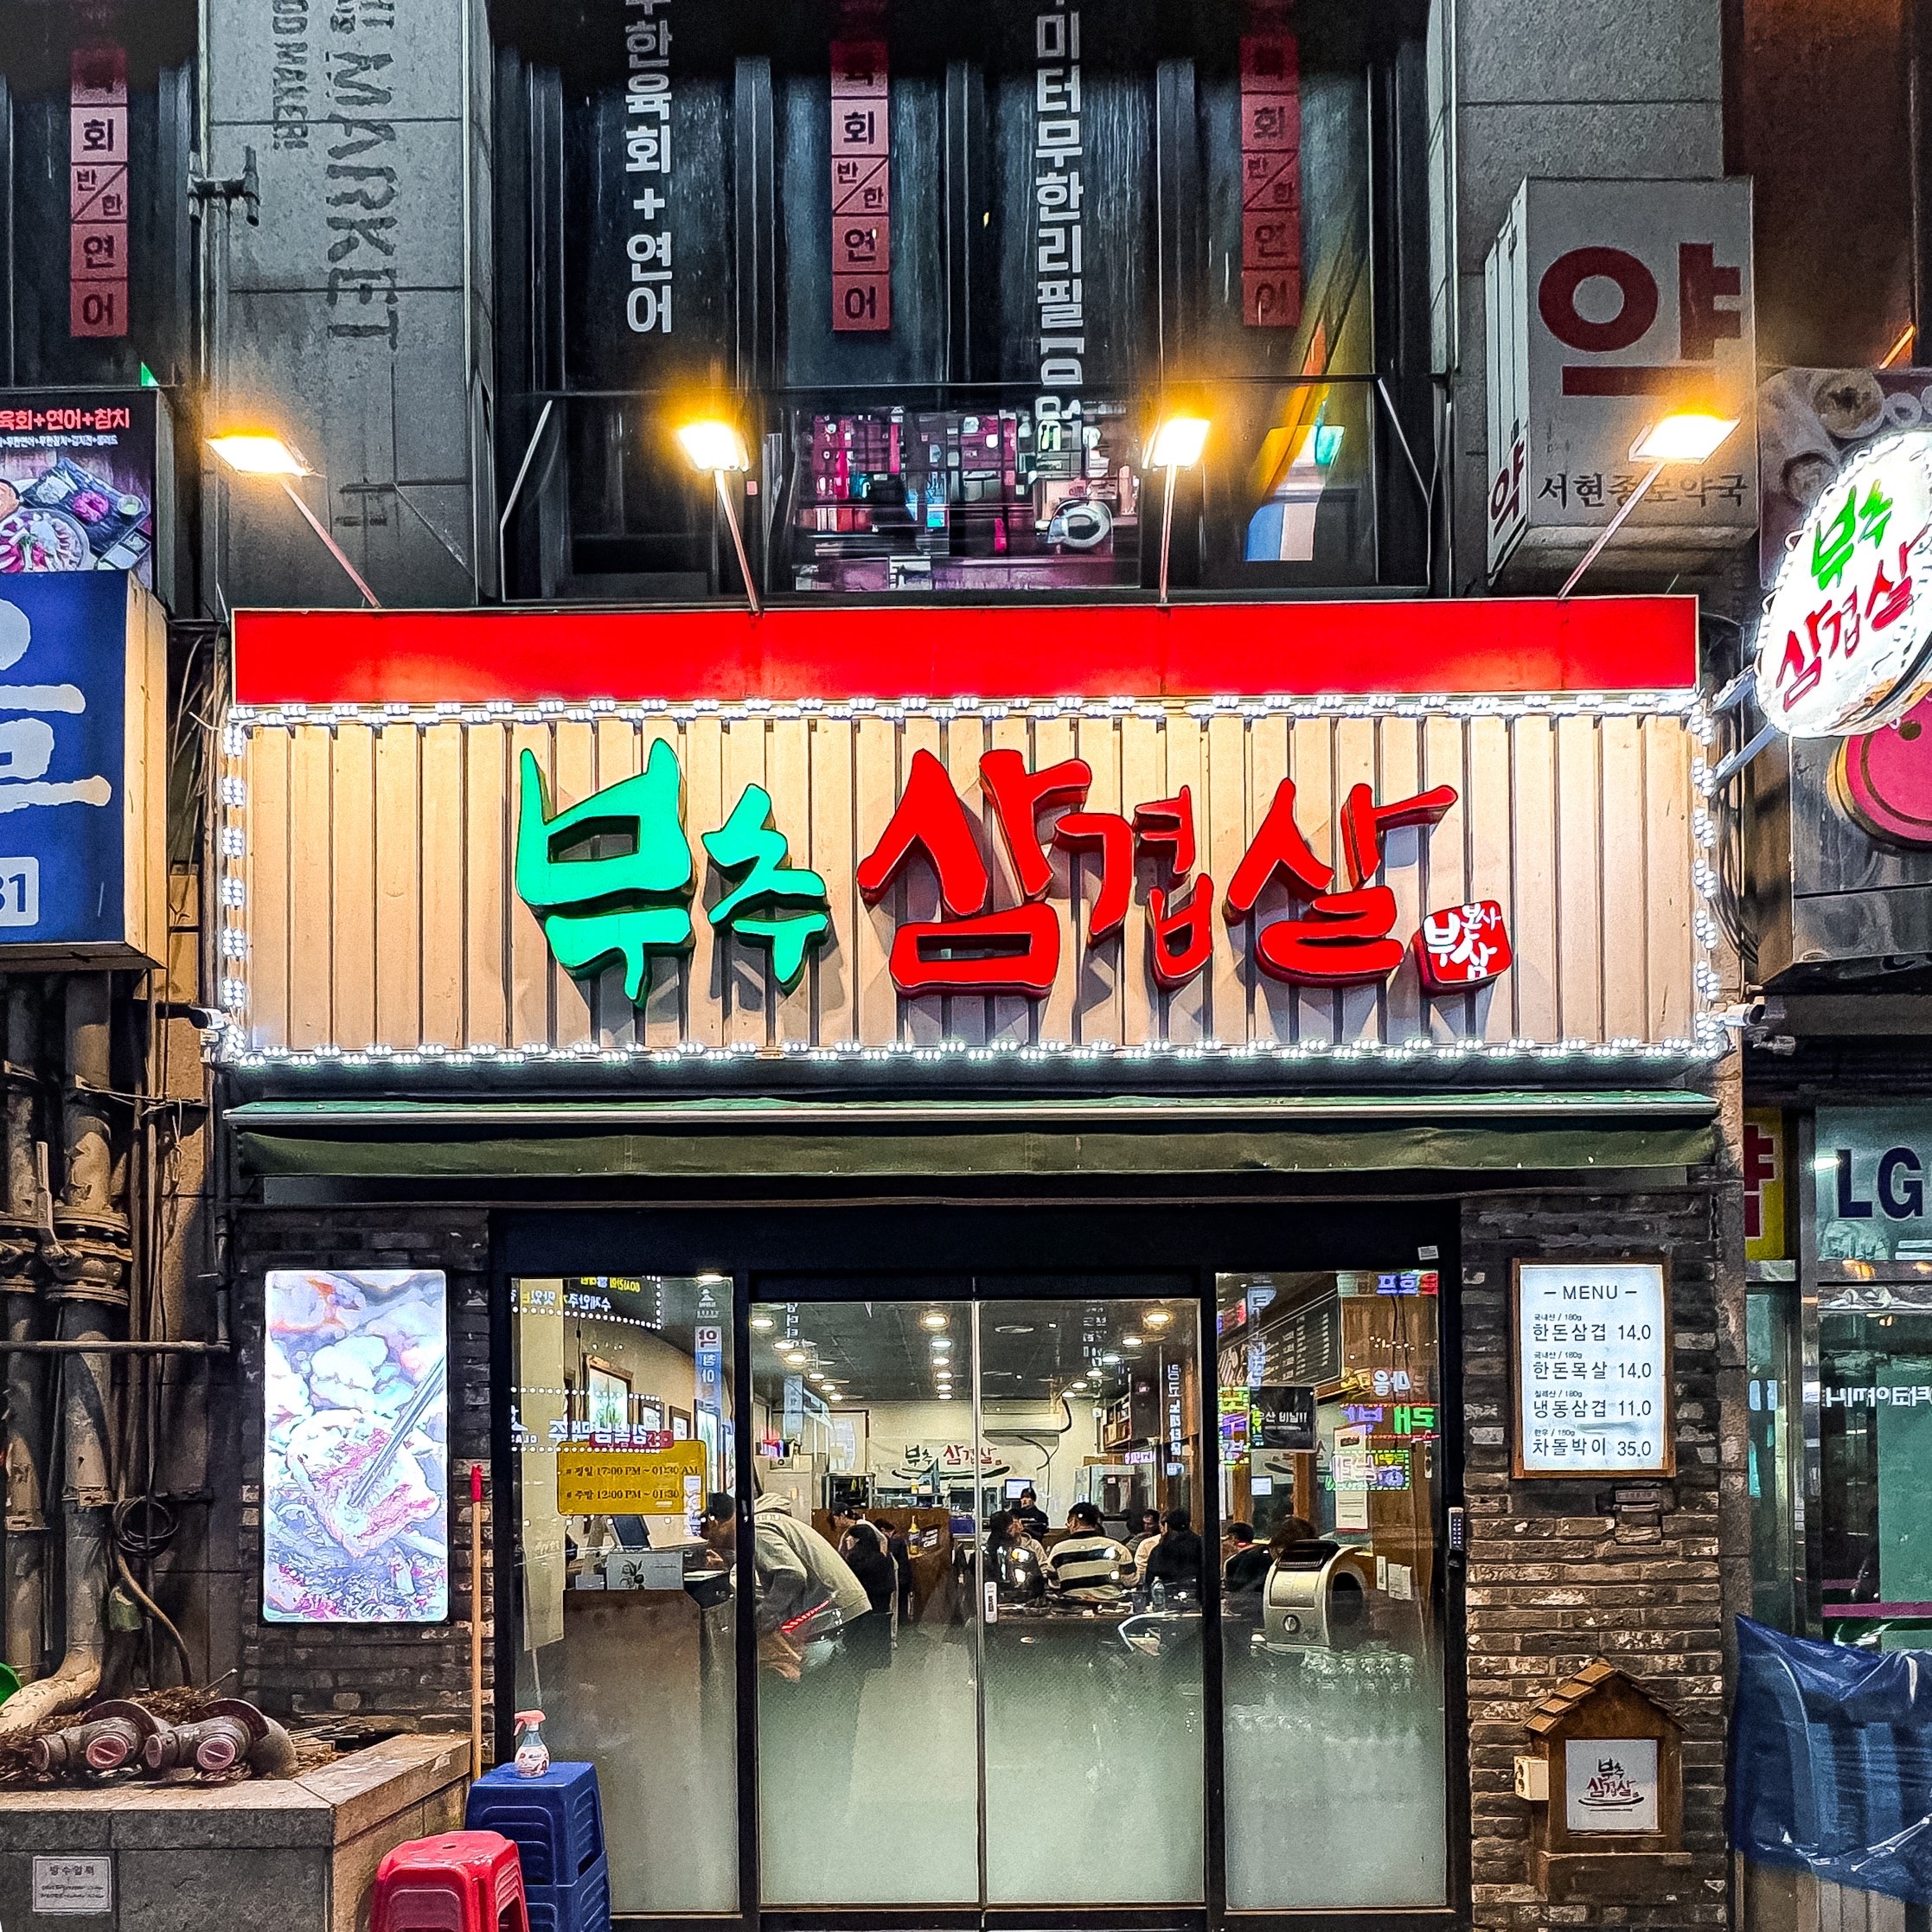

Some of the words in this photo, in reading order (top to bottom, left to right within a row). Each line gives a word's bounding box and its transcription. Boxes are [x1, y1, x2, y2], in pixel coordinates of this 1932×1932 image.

[327, 50, 398, 351] MARKET
[626, 231, 673, 334] 연어
[1538, 242, 1741, 396] 약
[515, 738, 828, 1001] 부추
[857, 748, 1458, 989] 삼겹살
[1837, 1147, 1923, 1219] LG
[1563, 1285, 1618, 1300] MENU
[1532, 1323, 1607, 1341] 한돈삼겹
[1618, 1324, 1651, 1341] 14.0
[1532, 1361, 1608, 1379] 한돈목살
[1618, 1362, 1651, 1379] 14.0
[1533, 1400, 1607, 1418] 냉동삼겹
[1618, 1401, 1651, 1417] 11.0
[1532, 1437, 1606, 1456] 차돌박이
[1617, 1440, 1651, 1457] 35.0
